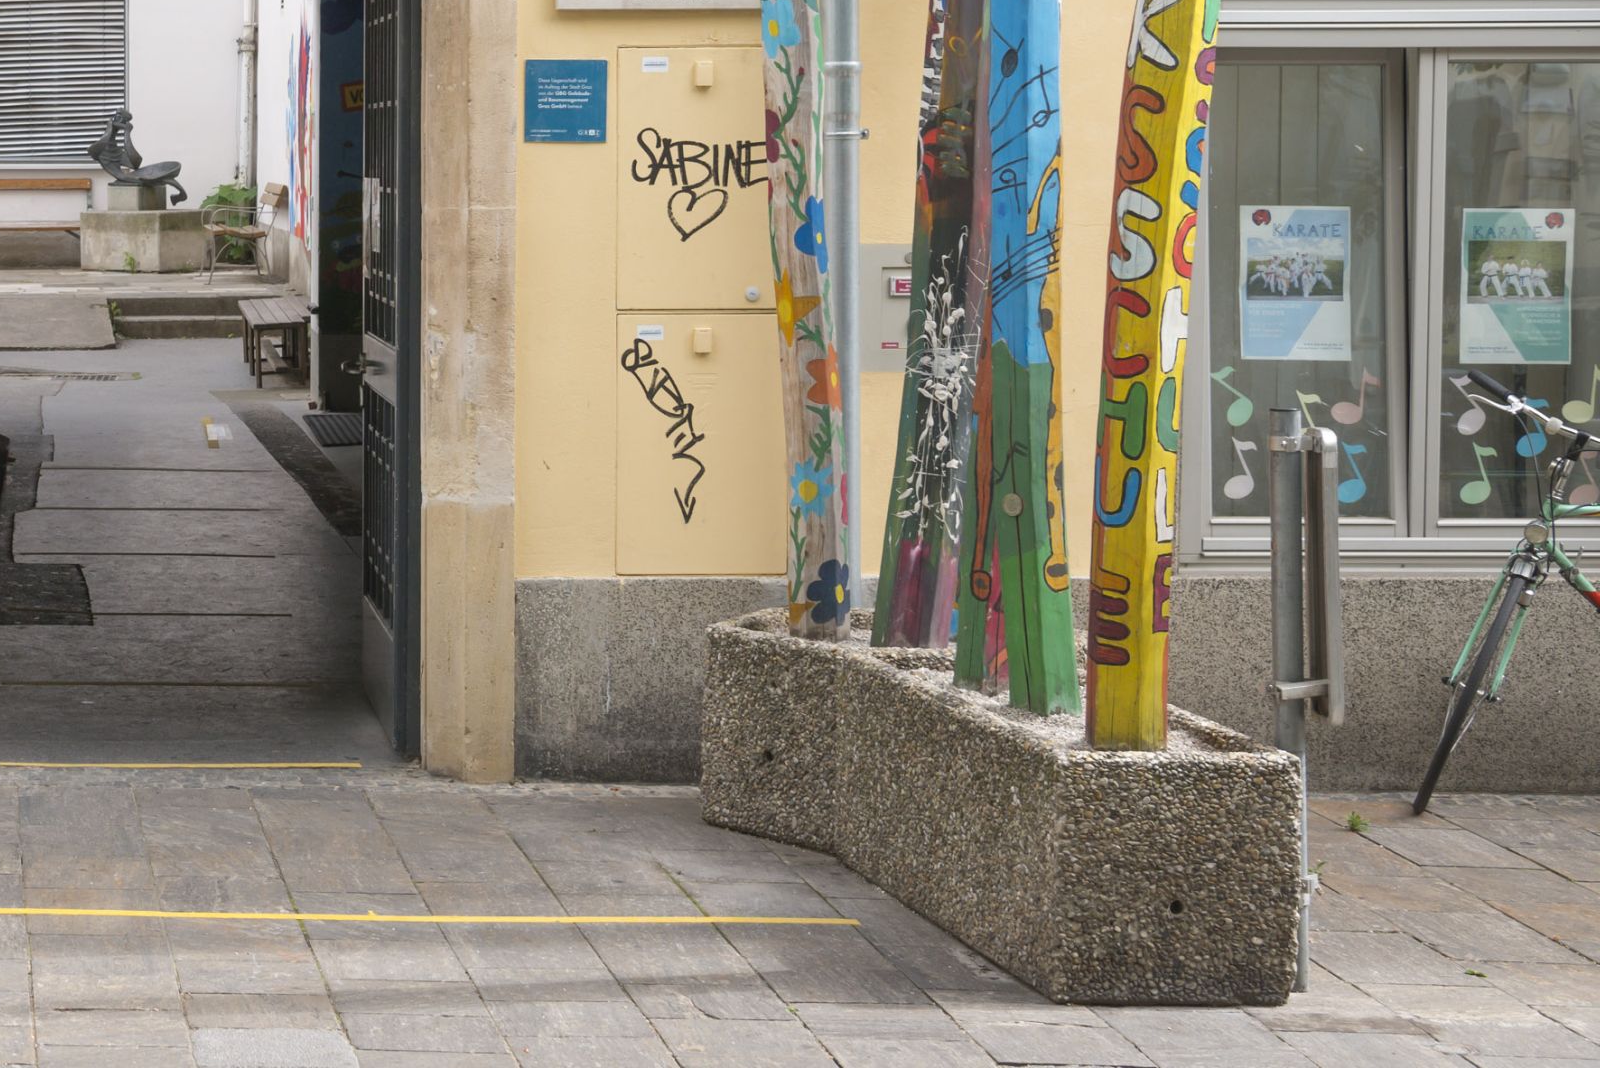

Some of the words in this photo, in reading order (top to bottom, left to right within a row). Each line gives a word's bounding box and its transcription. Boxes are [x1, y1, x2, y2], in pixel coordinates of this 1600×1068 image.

[631, 127, 769, 189] SABINE
[1272, 223, 1342, 238] KARATE
[1471, 225, 1543, 240] KARATE
